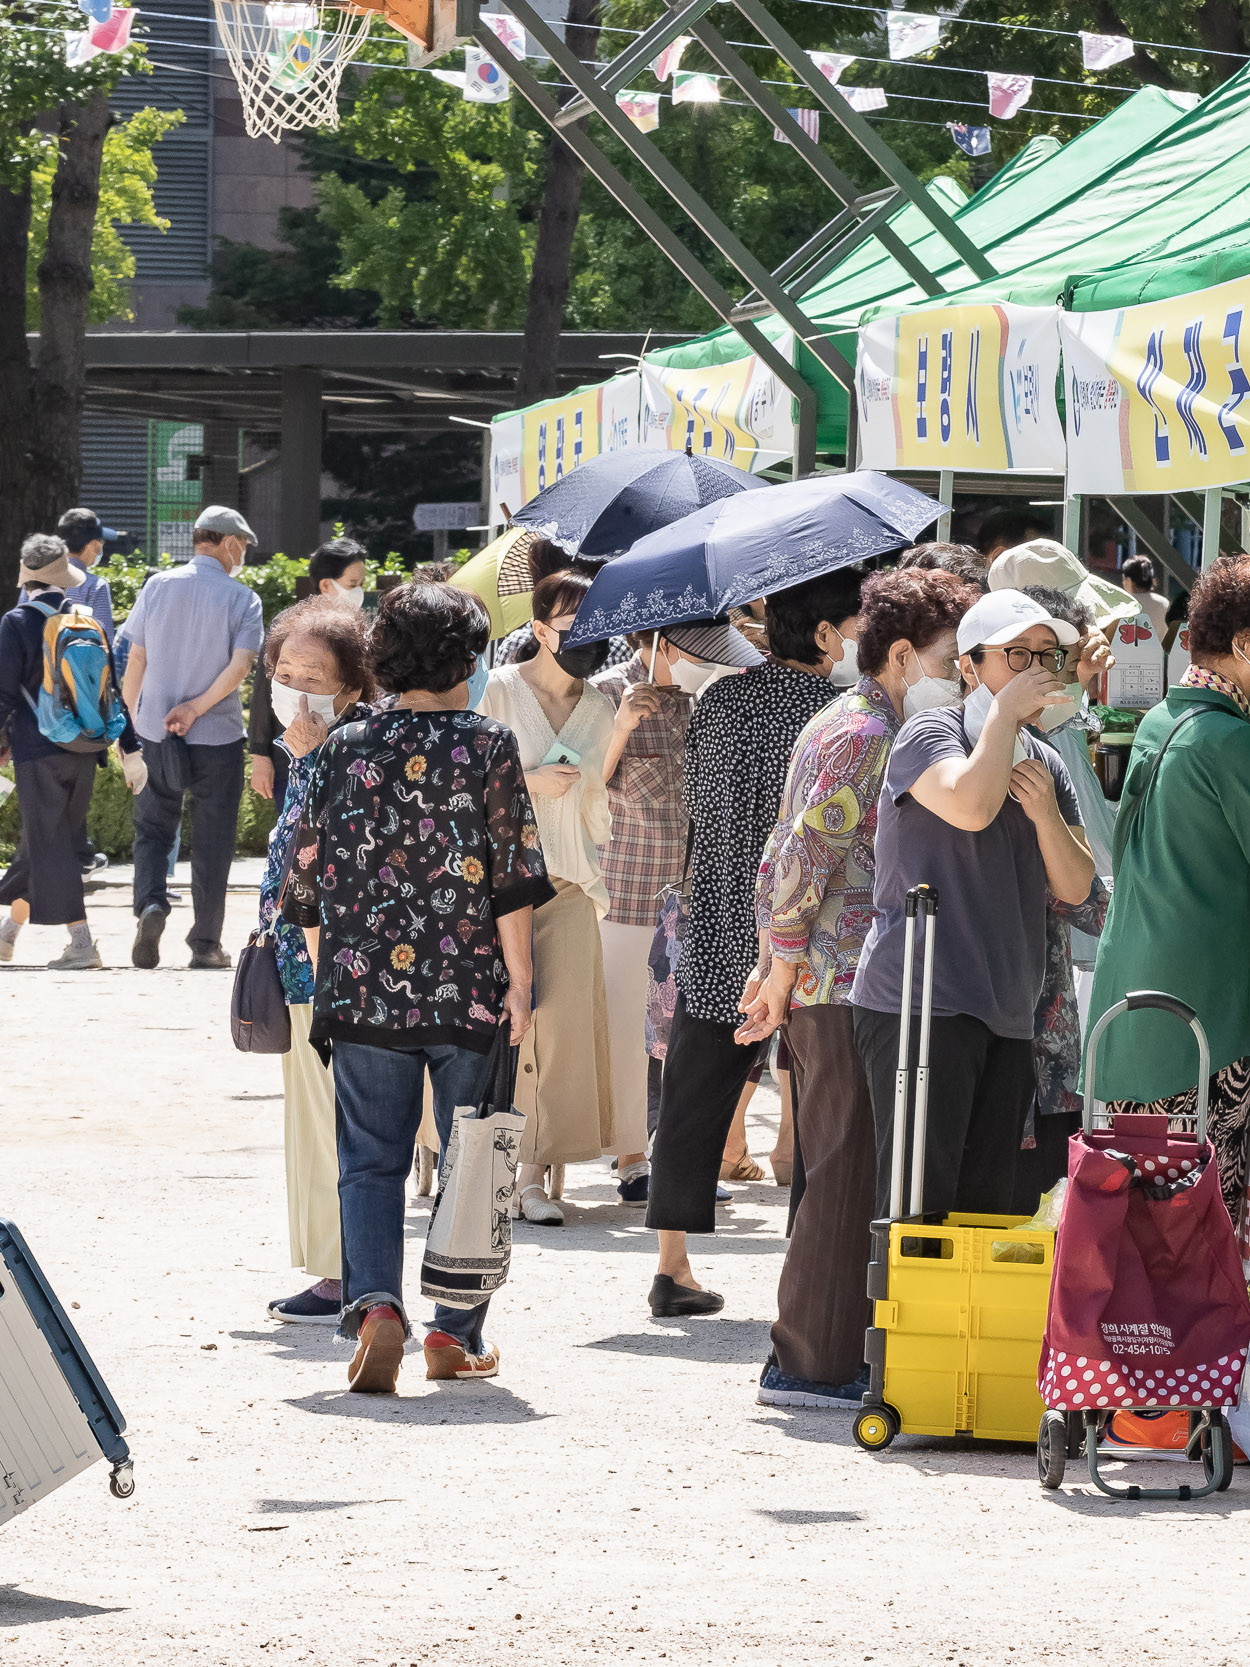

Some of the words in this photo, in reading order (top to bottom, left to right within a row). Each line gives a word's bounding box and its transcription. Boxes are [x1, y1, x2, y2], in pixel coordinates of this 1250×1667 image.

[917, 329, 980, 443] 보령시
[1137, 310, 1250, 462] 인제군
[1101, 1323, 1119, 1334] 경희
[1120, 1323, 1149, 1335] 사계절
[1150, 1323, 1172, 1339] 한의원
